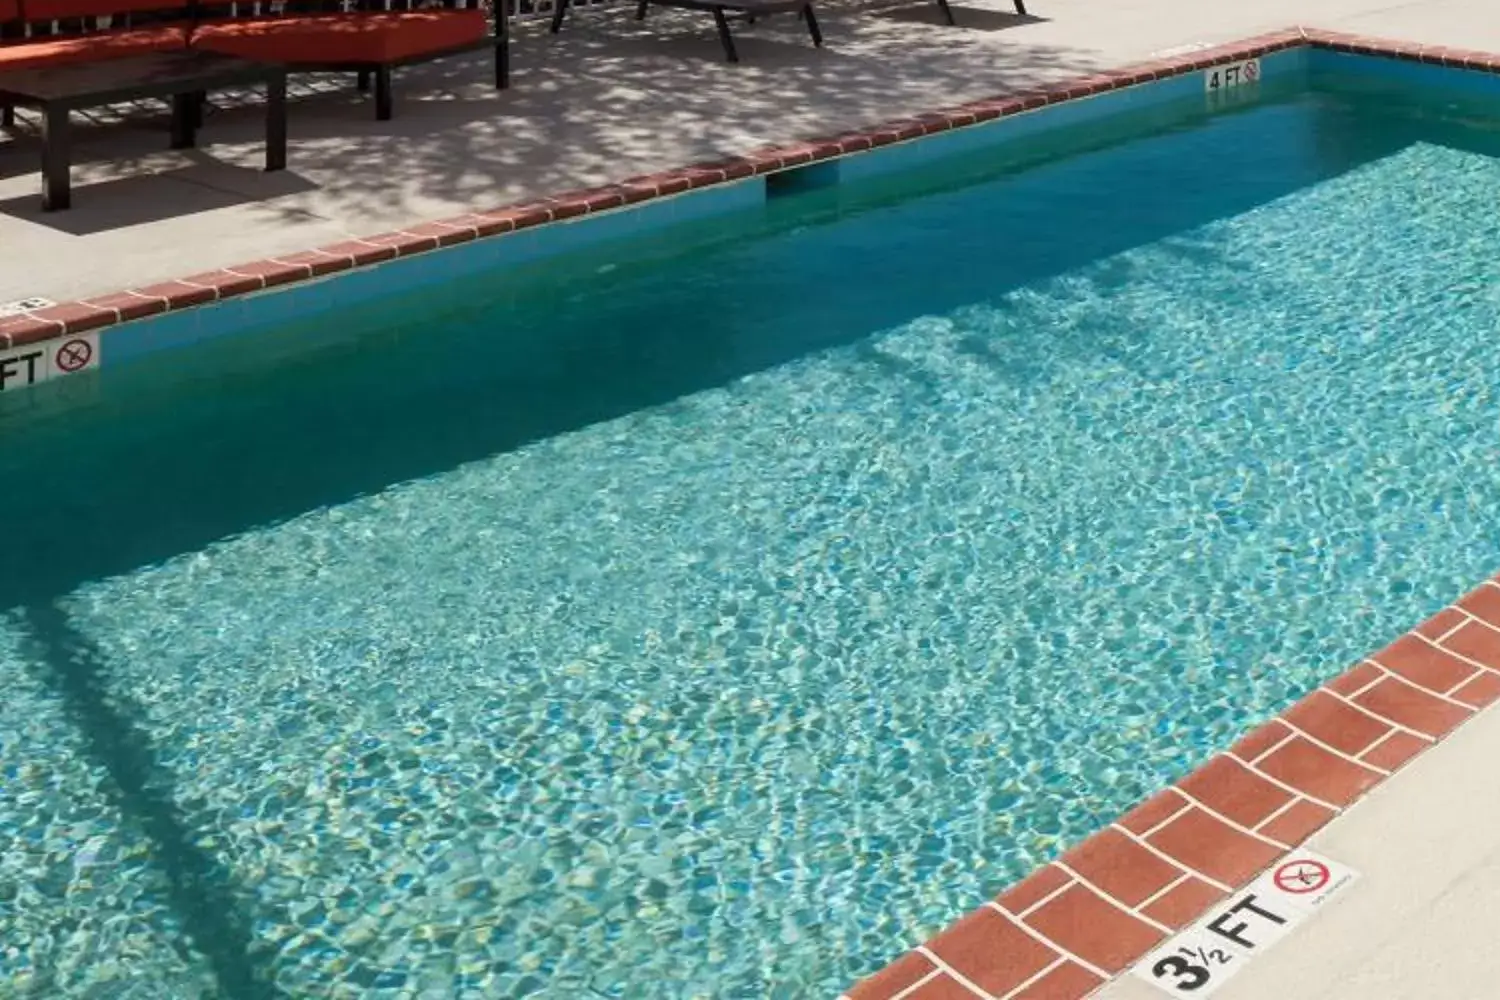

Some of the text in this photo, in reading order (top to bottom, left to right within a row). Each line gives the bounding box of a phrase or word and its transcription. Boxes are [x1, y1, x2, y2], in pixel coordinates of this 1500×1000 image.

[1210, 66, 1241, 88] 4 FT
[1206, 893, 1287, 950] FT
